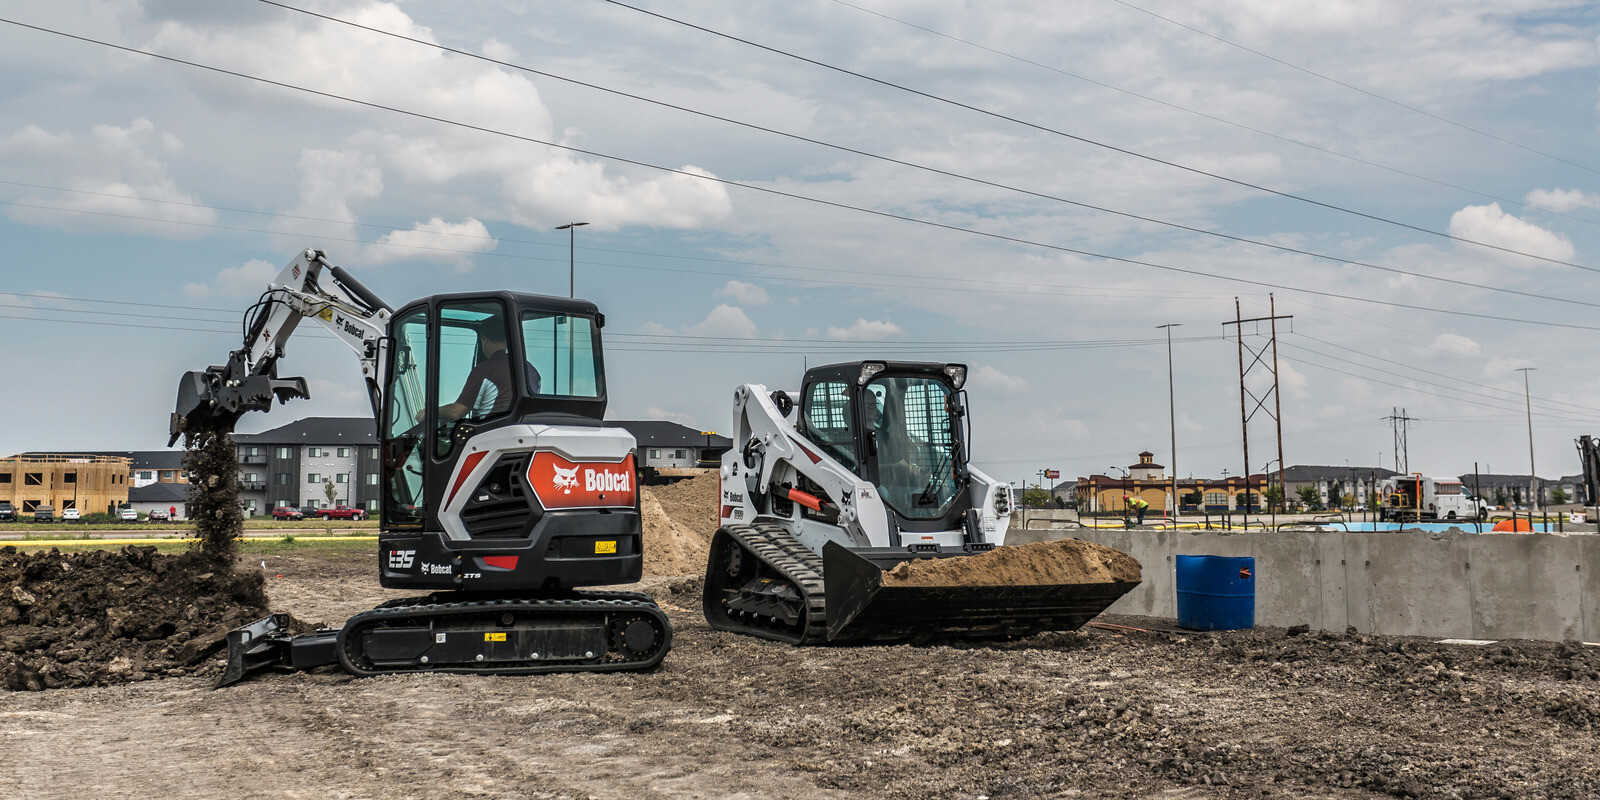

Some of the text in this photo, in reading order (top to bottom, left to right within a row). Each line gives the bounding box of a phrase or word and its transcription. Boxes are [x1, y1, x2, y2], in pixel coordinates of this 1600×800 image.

[344, 320, 365, 340] Bobcat
[585, 469, 630, 492] Bobcat
[388, 550, 416, 569] E35
[430, 564, 452, 574] Bobcat
